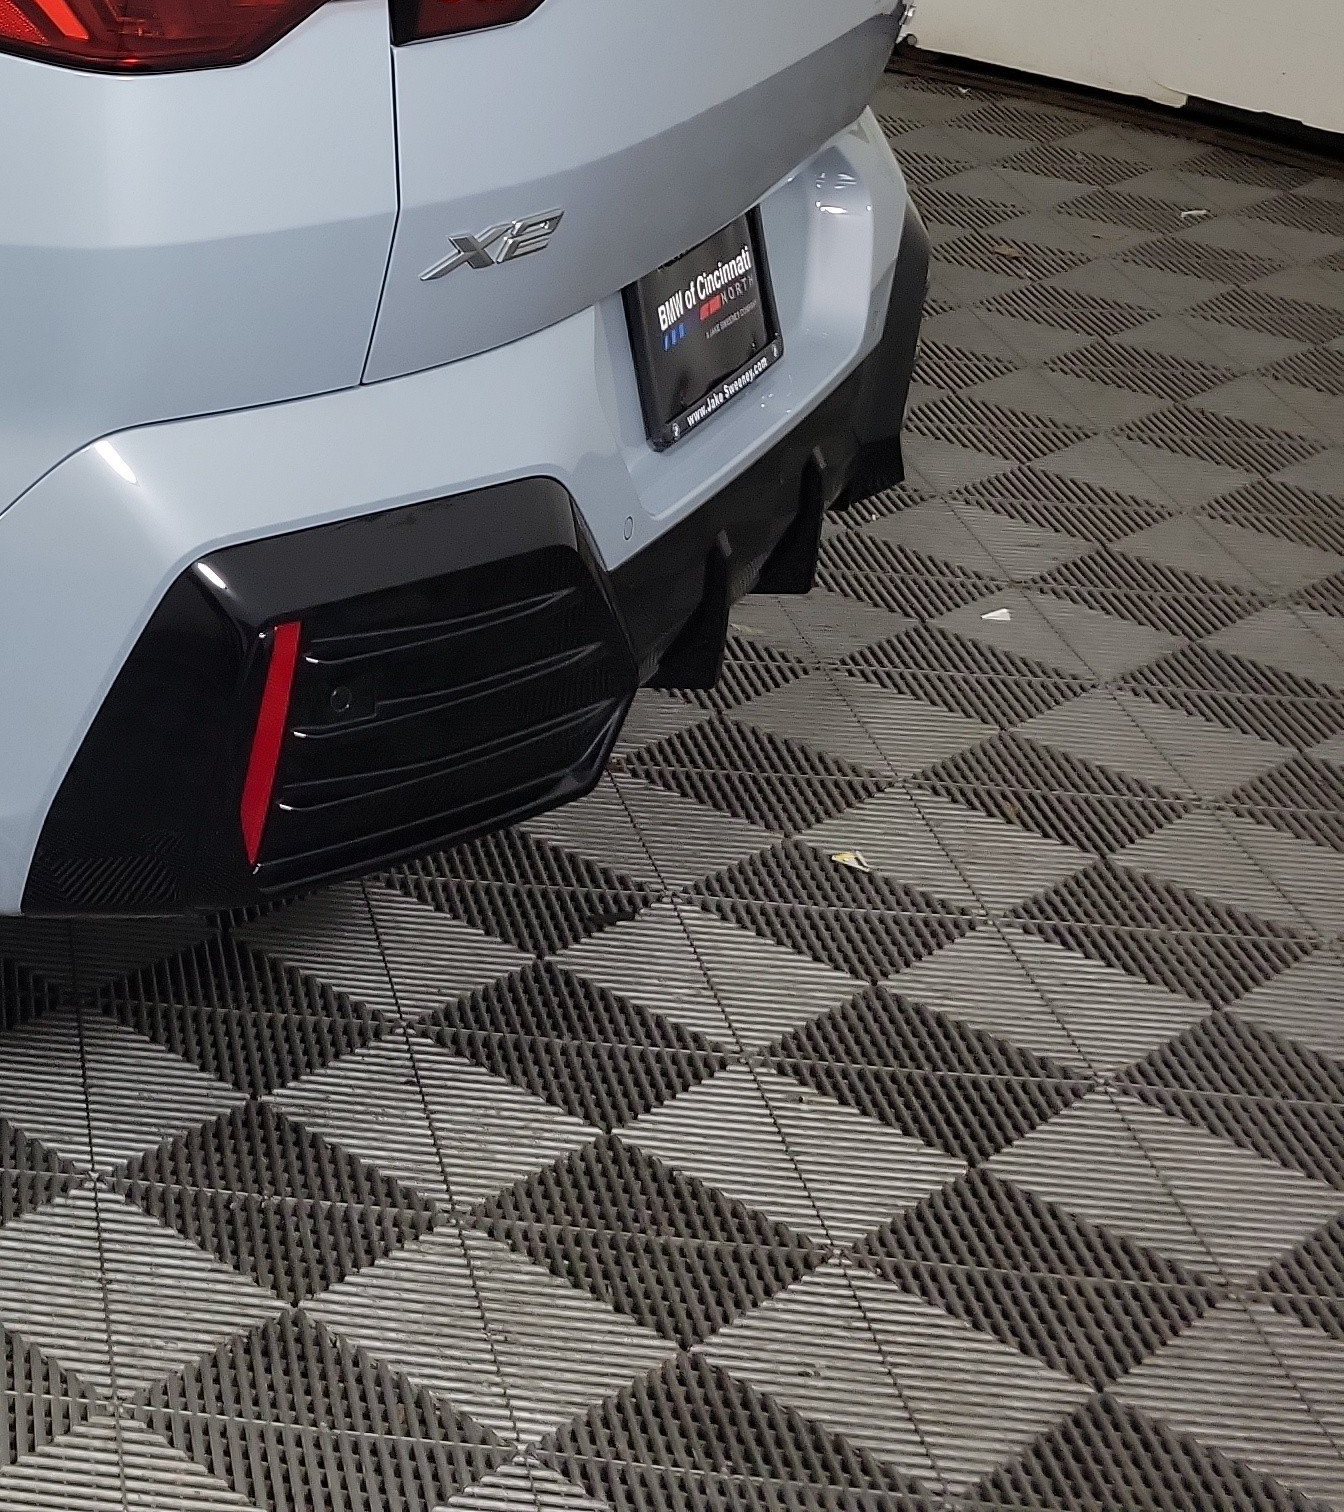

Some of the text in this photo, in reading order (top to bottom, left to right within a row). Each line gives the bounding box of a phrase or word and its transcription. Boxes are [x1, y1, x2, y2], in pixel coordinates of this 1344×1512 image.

[419, 207, 565, 281] X2
[657, 245, 752, 330] BMW of Cincinnati
